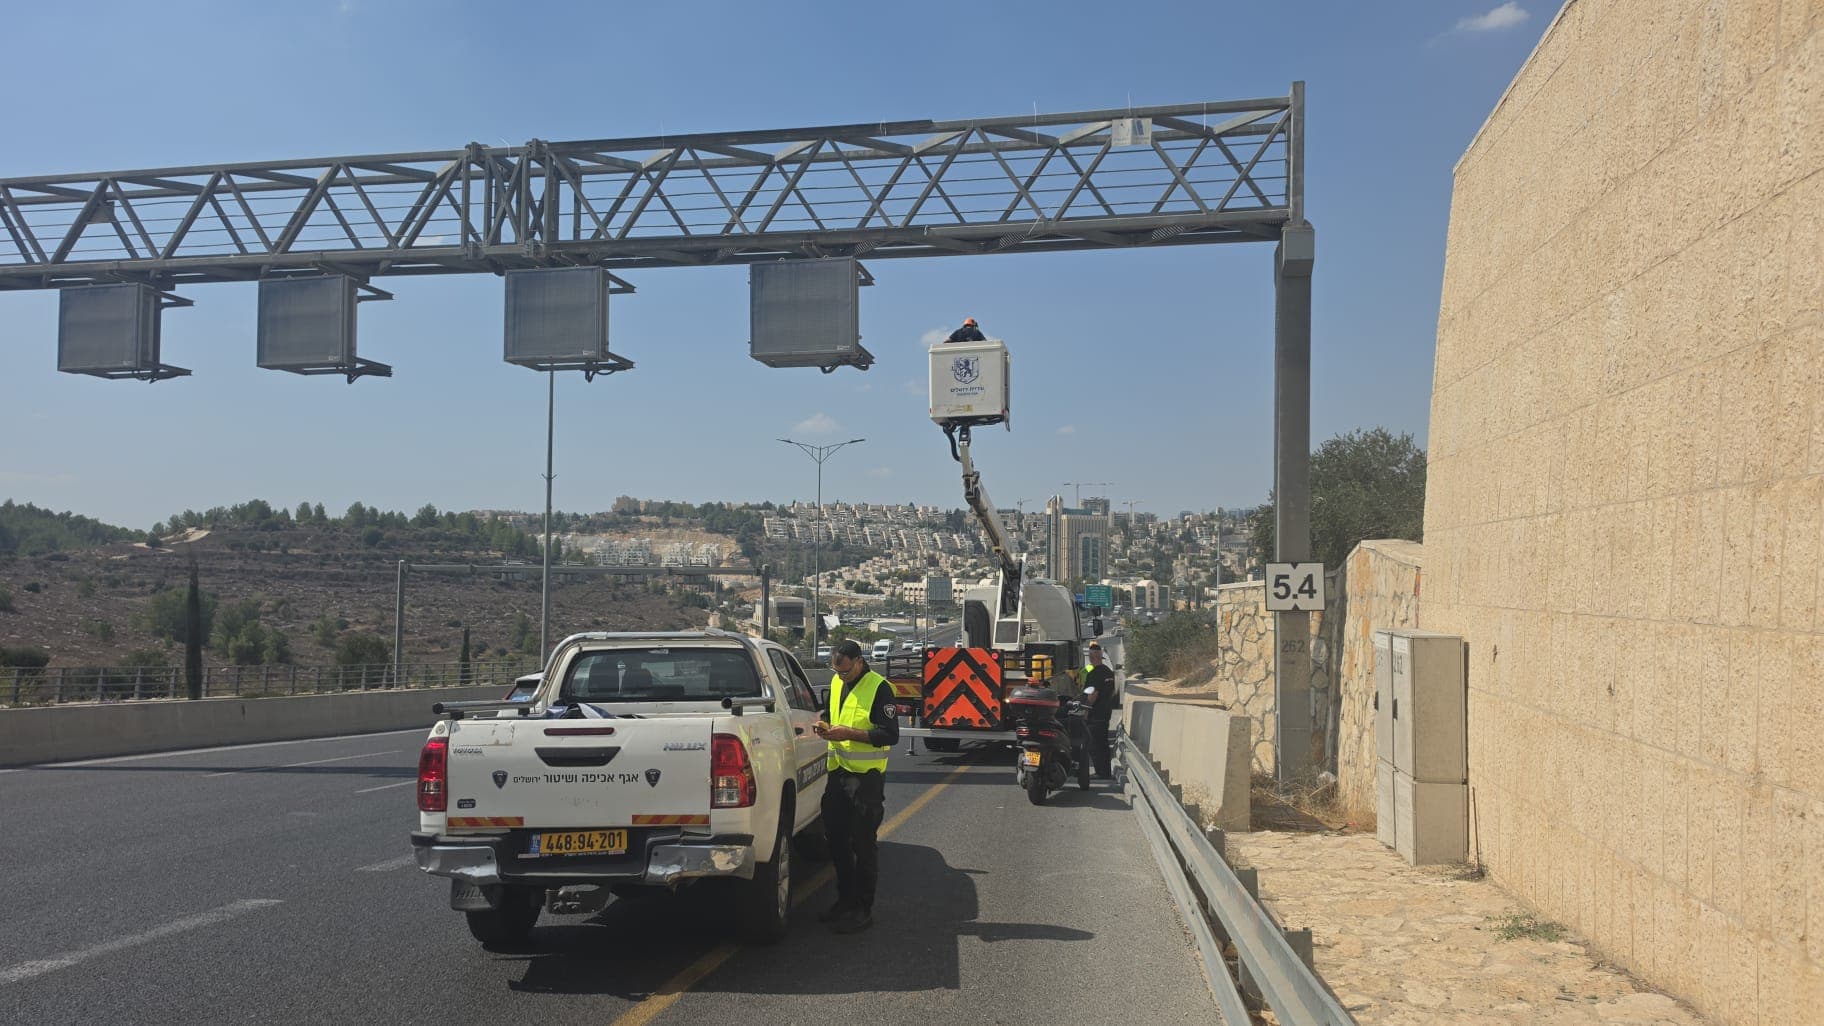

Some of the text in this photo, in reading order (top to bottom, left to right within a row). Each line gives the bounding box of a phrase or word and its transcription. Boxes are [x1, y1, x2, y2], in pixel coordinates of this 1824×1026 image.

[1273, 573, 1317, 600] 5.4
[1281, 640, 1305, 653] 262
[513, 773, 639, 785] אגף אכיפה ושיטור ירושלים
